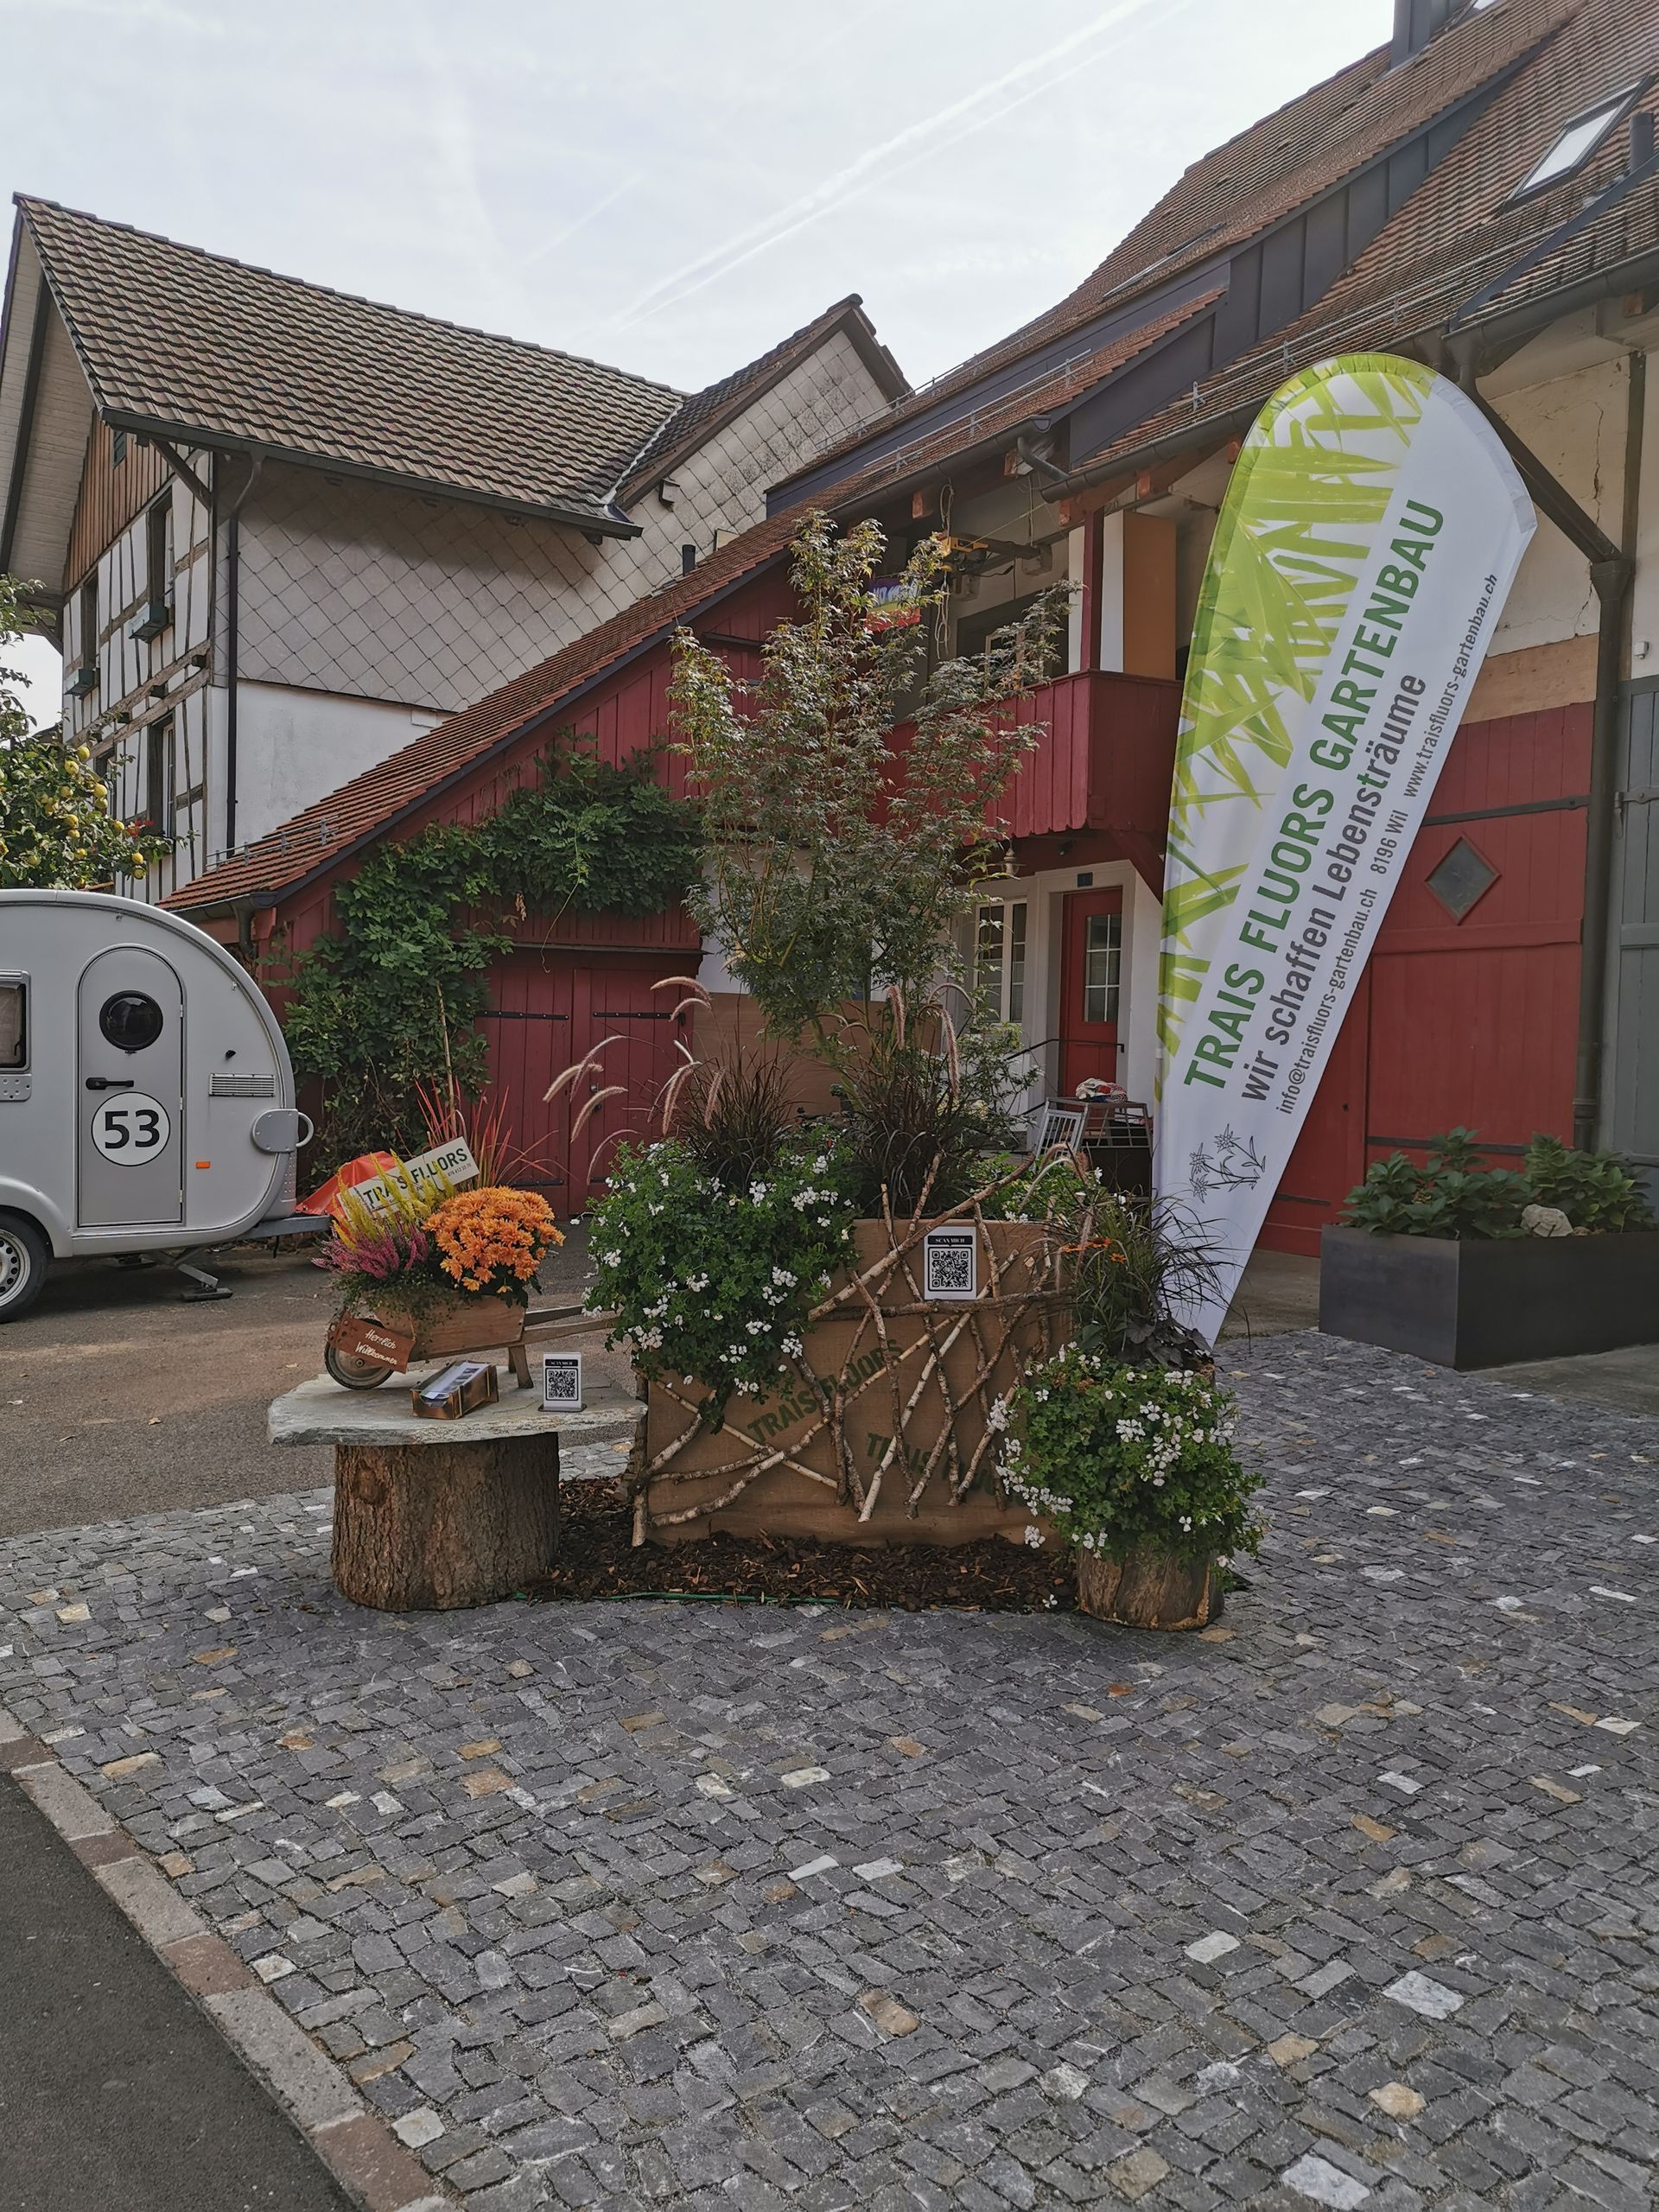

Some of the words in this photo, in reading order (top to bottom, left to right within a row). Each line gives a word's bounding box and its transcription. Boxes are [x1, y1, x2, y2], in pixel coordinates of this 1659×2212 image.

[1184, 963, 1265, 1089] TRAIS
[1238, 783, 1334, 953] FLUORS
[1309, 499, 1444, 771] GARTENBAU
[1275, 888, 1378, 1115] info@traisfluors-gartenbau.ch
[1370, 837, 1398, 875] 8196
[1384, 809, 1409, 835] Wil
[1403, 574, 1498, 798] www.traisfluors-gartenbau.ch
[1241, 1049, 1279, 1102] wir
[1265, 907, 1336, 1046] schaffen
[1312, 674, 1427, 901] Lebensträume
[105, 1109, 160, 1149] 53
[363, 1175, 408, 1206] TRAS
[355, 1341, 397, 1365] Willkommen
[365, 1329, 397, 1349] Herzlich
[747, 1389, 817, 1443] TRAIS
